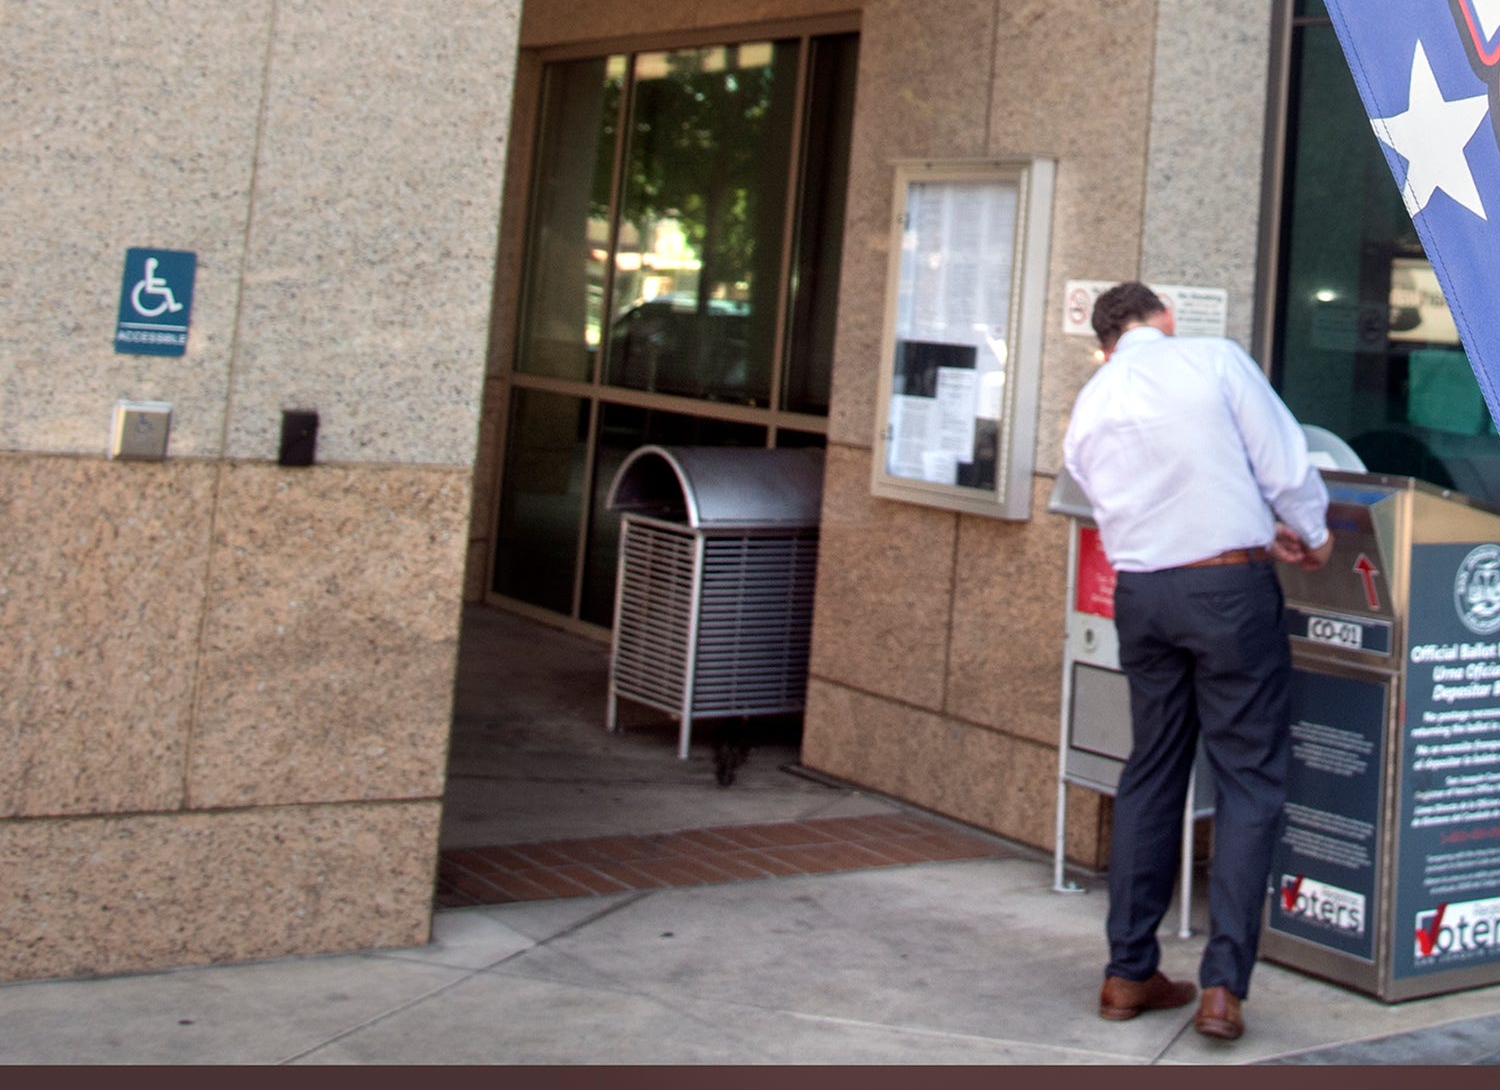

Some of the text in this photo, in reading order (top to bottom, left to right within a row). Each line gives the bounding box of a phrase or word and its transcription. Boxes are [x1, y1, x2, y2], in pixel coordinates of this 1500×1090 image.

[117, 330, 187, 345] ACCESSIBLE
[1312, 619, 1358, 644] CO-01
[1410, 643, 1459, 663] Official
[1460, 642, 1497, 661] Ballot
[1432, 665, 1464, 682] Urna
[1432, 683, 1492, 704] Depositar
